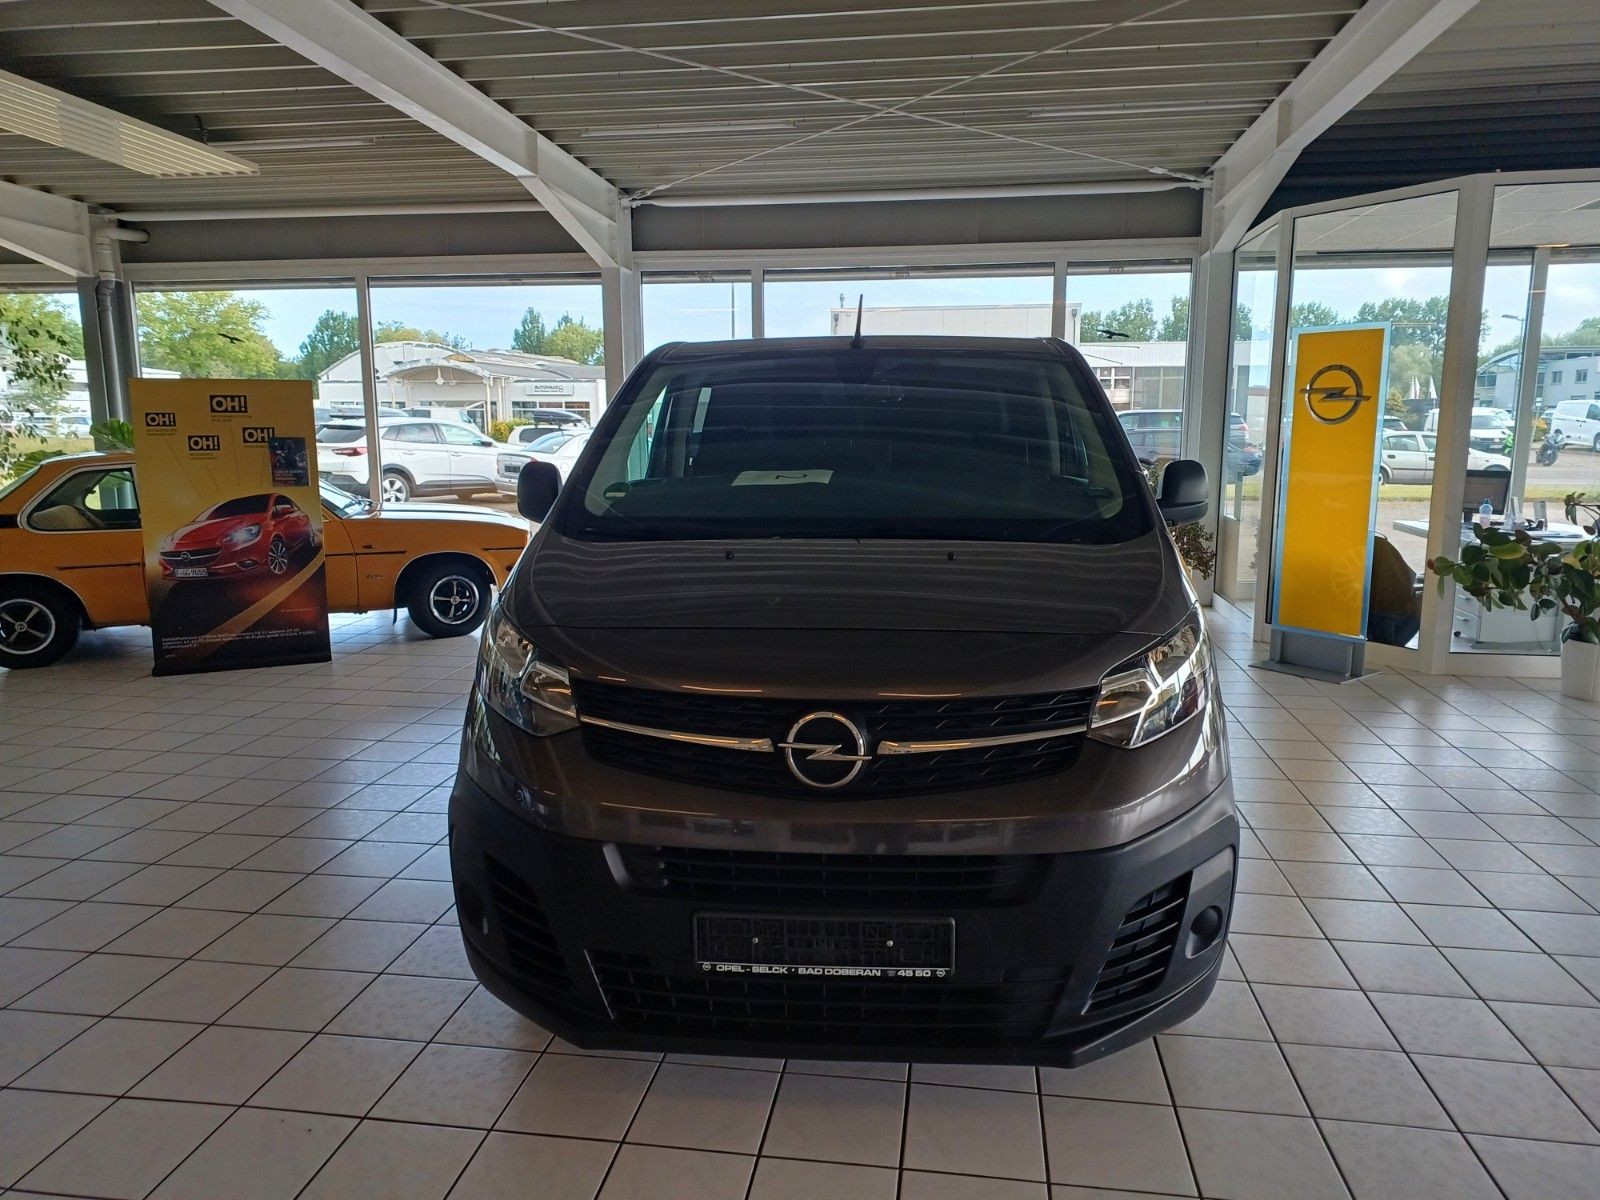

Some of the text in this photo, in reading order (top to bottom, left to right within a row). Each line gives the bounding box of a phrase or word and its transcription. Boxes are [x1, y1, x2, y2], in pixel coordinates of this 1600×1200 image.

[211, 397, 246, 412] OH!
[146, 414, 175, 426] OH!
[244, 428, 273, 442] OH!
[189, 436, 218, 450] OH!
[798, 967, 823, 975] BAD
[824, 968, 881, 977] DOBERAN
